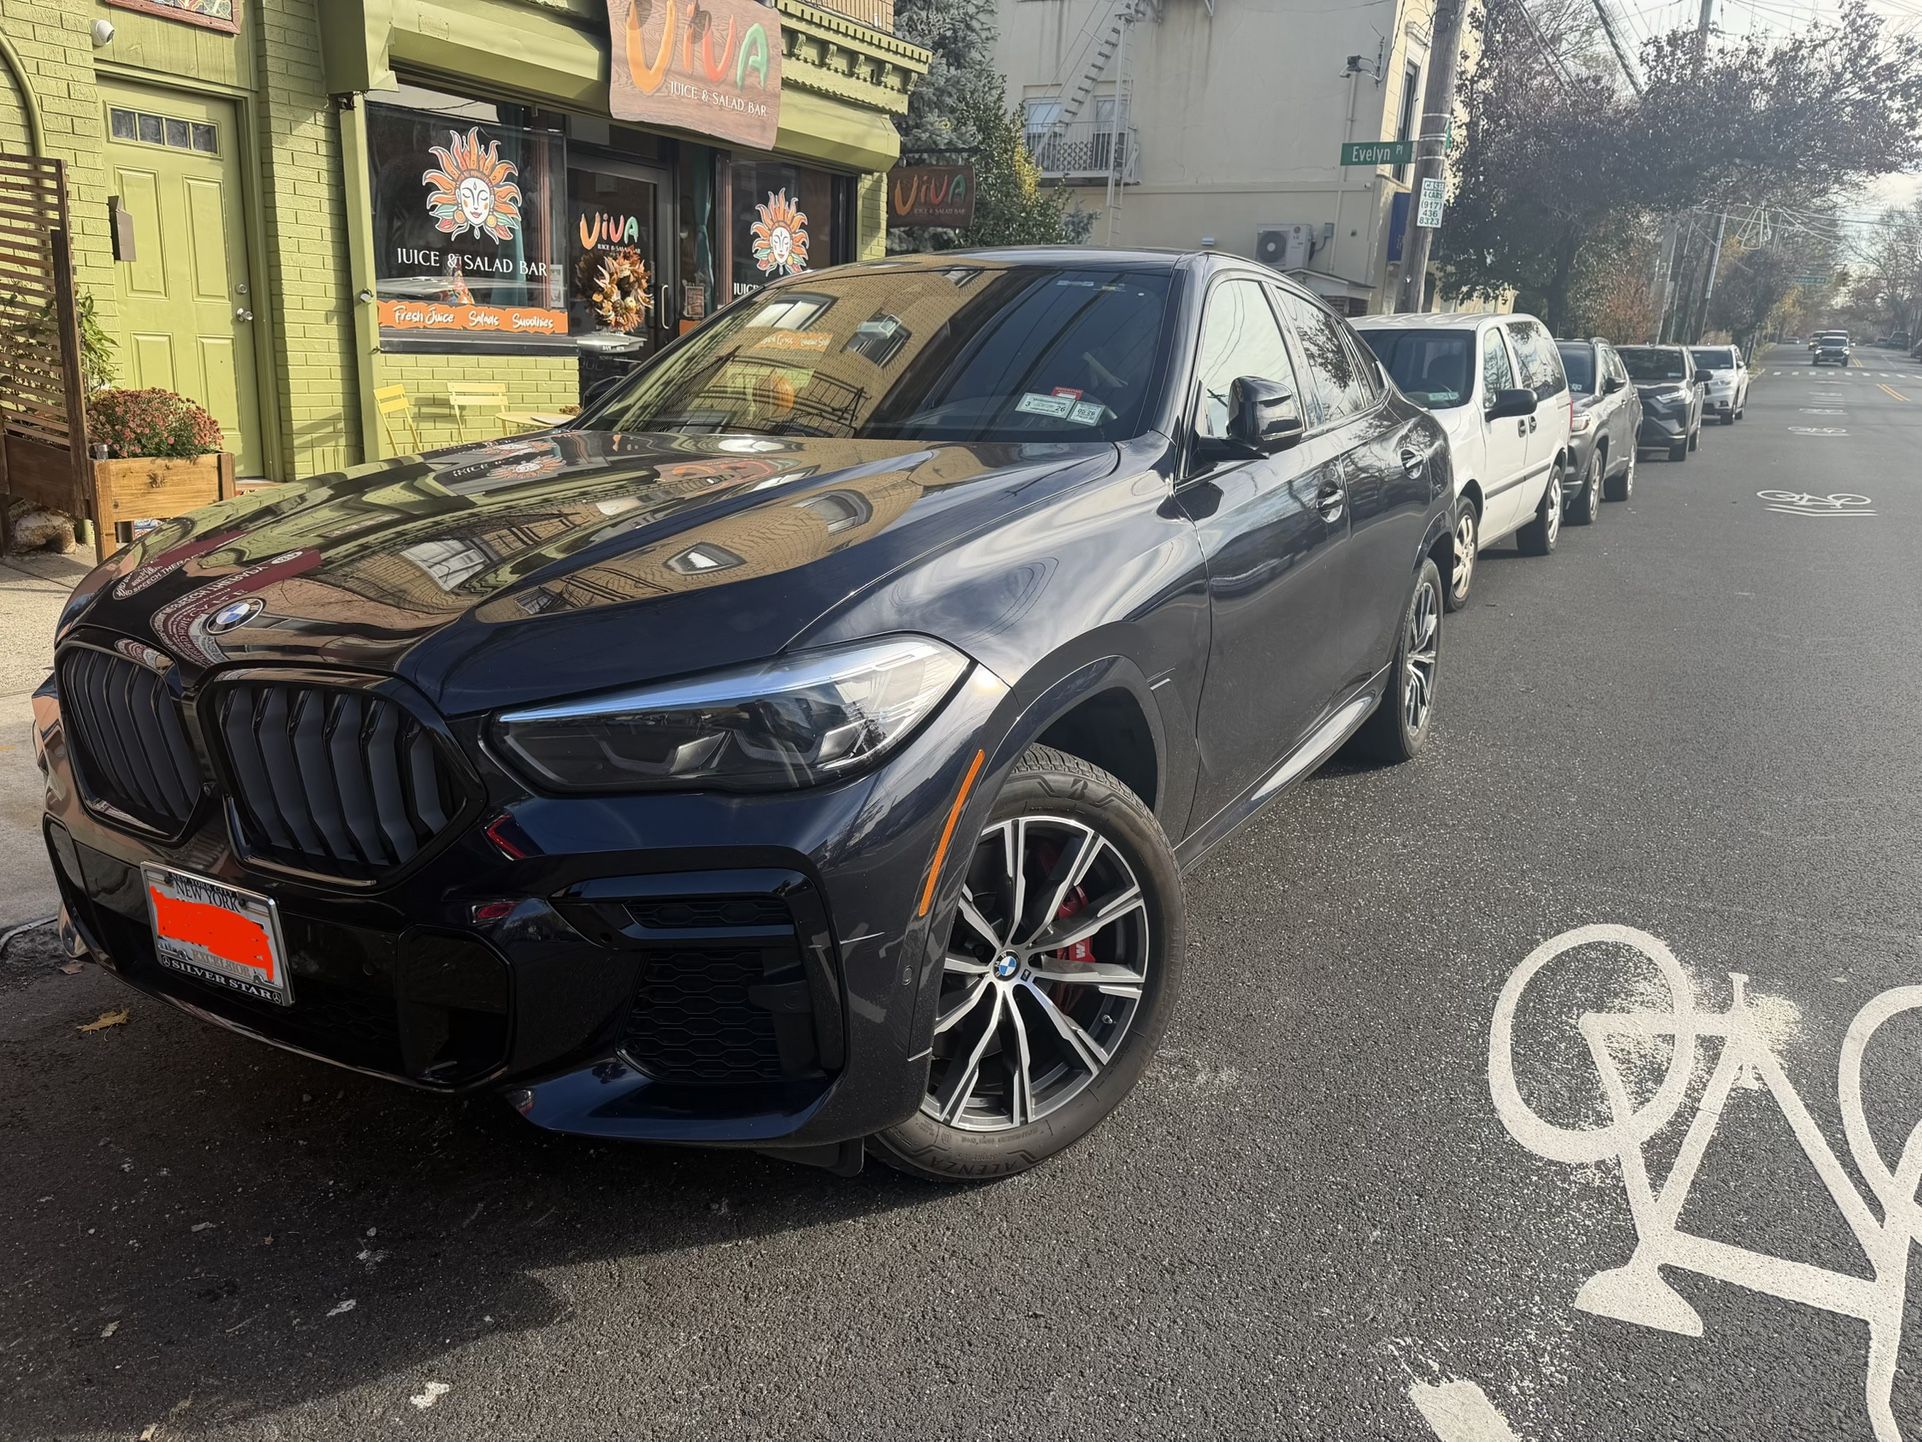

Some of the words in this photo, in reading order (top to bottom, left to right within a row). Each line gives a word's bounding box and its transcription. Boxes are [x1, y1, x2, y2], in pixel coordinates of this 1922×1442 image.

[670, 81, 697, 100] JUICE
[701, 90, 709, 101] &
[712, 92, 744, 111] SALAD
[747, 102, 767, 117] BAR
[1352, 146, 1390, 162] Evelyn
[1428, 191, 1443, 199] CARS
[1421, 200, 1442, 210] (917)
[1422, 209, 1438, 217] 436
[1419, 217, 1439, 225] 8323
[397, 248, 440, 267] JUICE
[447, 253, 457, 269] &
[465, 254, 513, 273] SALAD
[519, 260, 547, 277] BAR
[393, 305, 423, 323] Fresh
[425, 306, 455, 324] Juice
[468, 310, 500, 327] Salads
[174, 881, 202, 901] NEW
[205, 888, 240, 913] YORK
[172, 960, 226, 984] SILVER
[229, 979, 272, 1000] STAR
